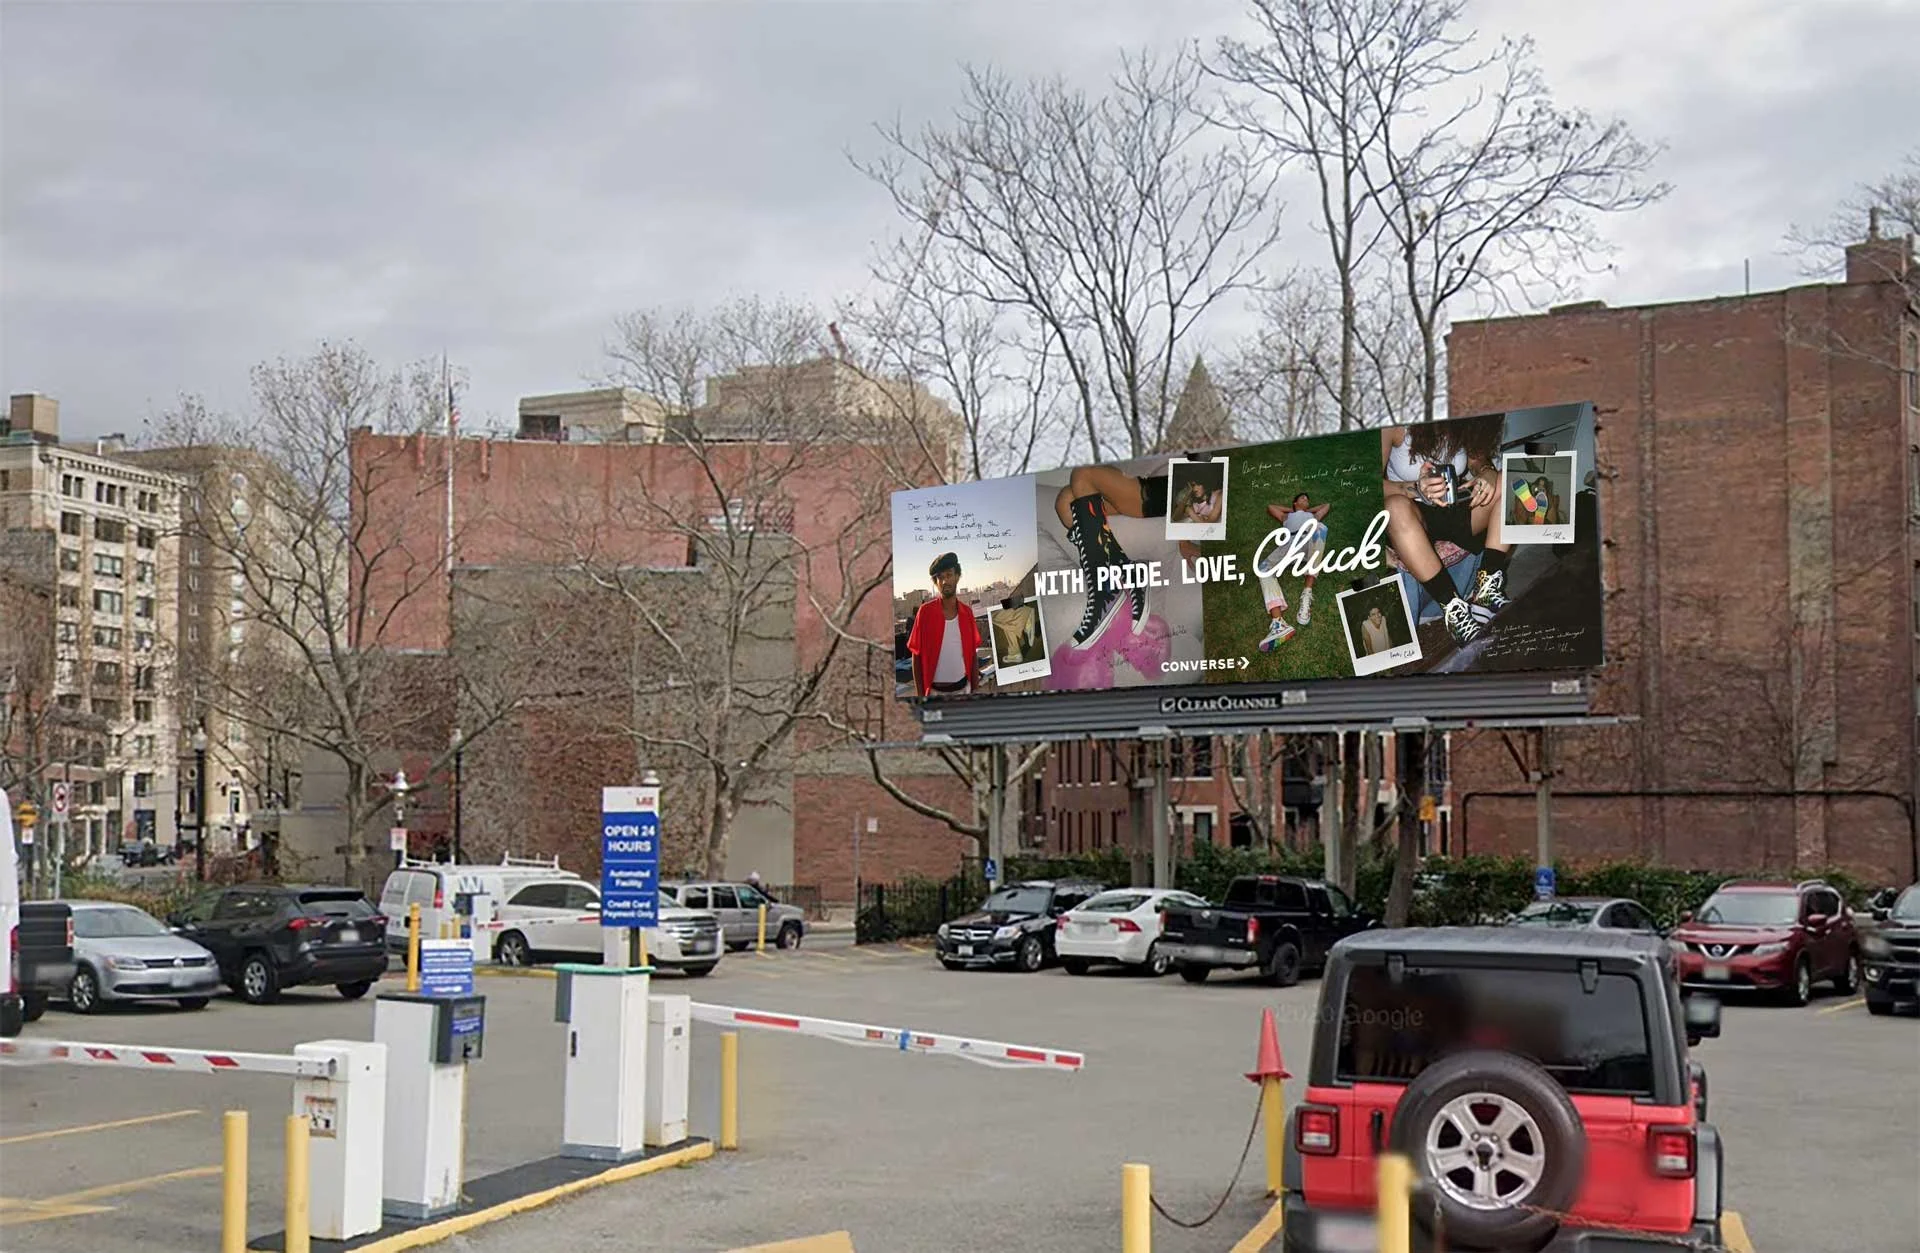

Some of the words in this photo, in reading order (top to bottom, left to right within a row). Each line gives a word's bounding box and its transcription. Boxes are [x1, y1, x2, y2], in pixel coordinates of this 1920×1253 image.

[1034, 568, 1084, 596] WITH
[1097, 561, 1169, 592] PRIDE.
[1181, 554, 1245, 586] LOVE,
[1253, 510, 1390, 578] Chuck
[1160, 658, 1235, 673] CONVERSE
[604, 825, 639, 837] OPEN
[641, 825, 655, 836] 24
[608, 840, 652, 852] HOURS
[609, 869, 651, 878] Automated
[615, 878, 643, 888] Facility
[607, 900, 631, 909] Credit
[632, 900, 651, 909] Card
[602, 910, 635, 919] Payment
[636, 910, 655, 919] Only
